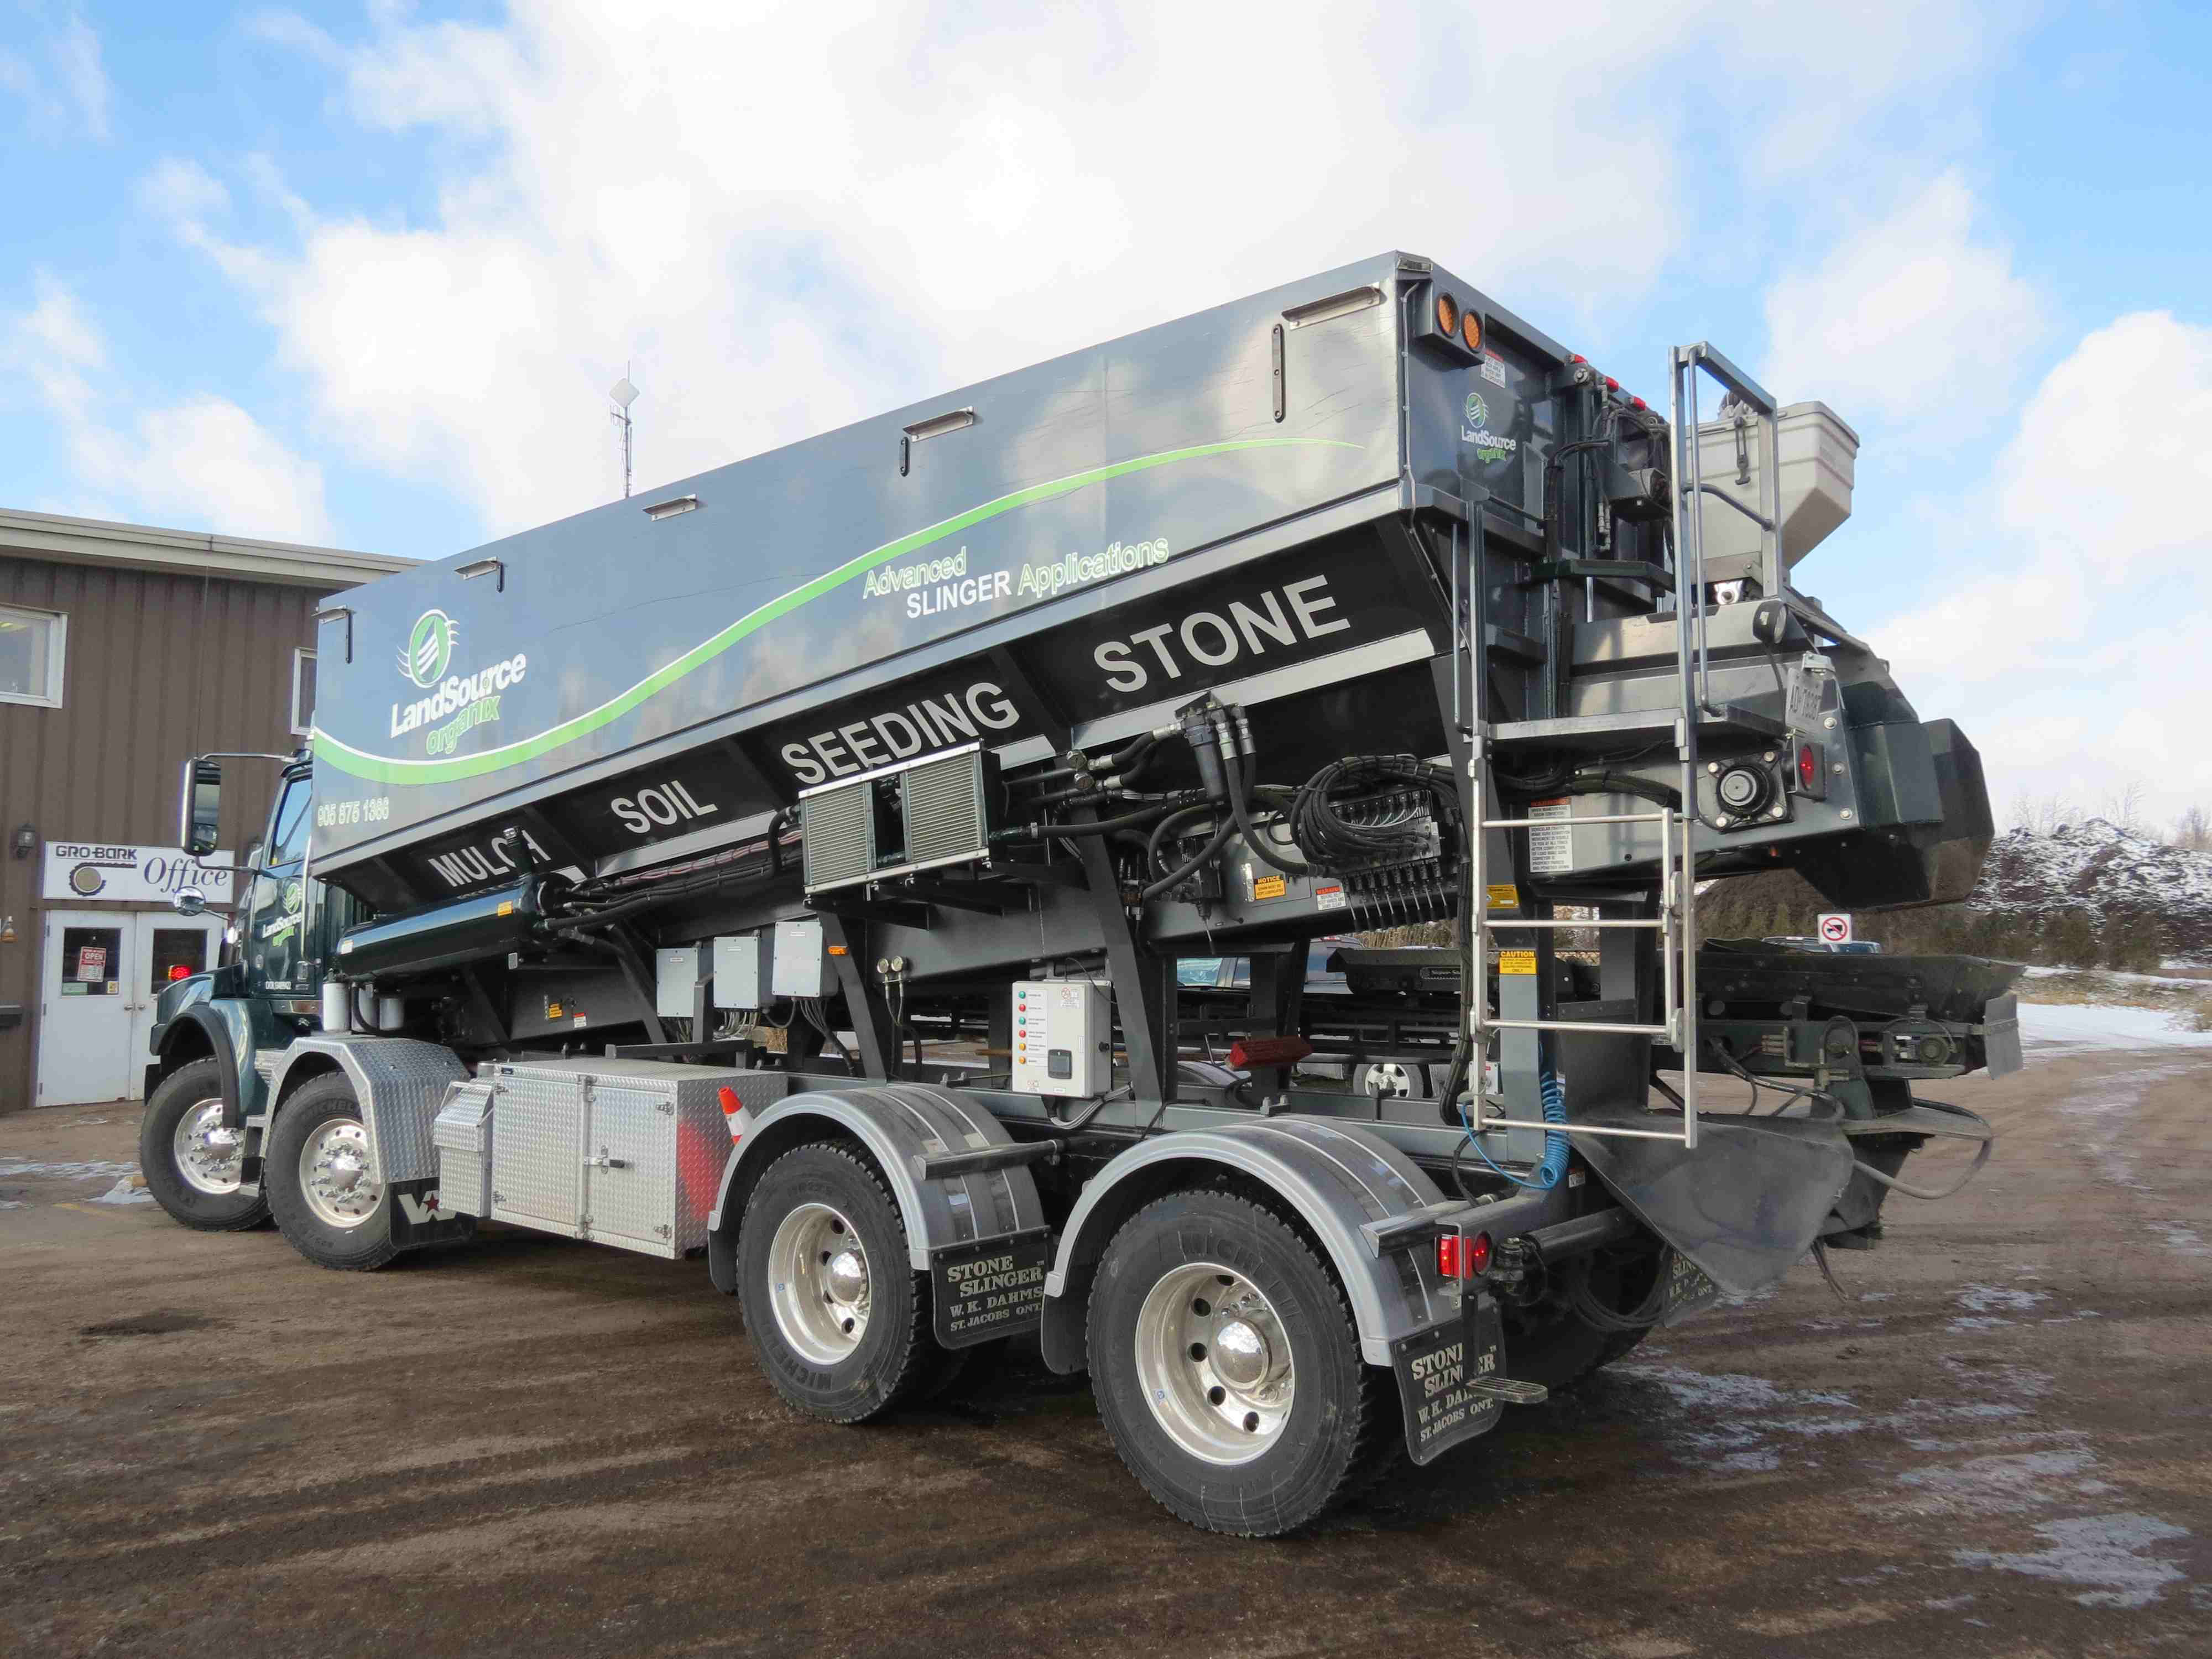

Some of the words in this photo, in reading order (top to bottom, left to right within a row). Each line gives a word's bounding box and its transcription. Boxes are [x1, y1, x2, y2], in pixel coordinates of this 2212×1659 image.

[1461, 425, 1516, 451] LandSource
[863, 546, 967, 599] Advanced
[906, 570, 1012, 618] SLINGER
[1017, 538, 1170, 598] Applications
[1094, 575, 1350, 692] STONE
[390, 653, 526, 738] LandSource
[426, 696, 501, 755] organix
[781, 682, 1020, 784] SEEDING
[611, 780, 718, 833] SOIL
[56, 845, 137, 860] GRO-BARK
[143, 857, 227, 894] Office
[947, 1255, 1014, 1283] STONE
[959, 1266, 1044, 1297] SLINGER
[950, 1304, 964, 1317] W.
[967, 1300, 982, 1313] K.
[987, 1286, 1044, 1309] DAHMS
[967, 1309, 1010, 1327] JACOBS
[1418, 1406, 1431, 1425] W.
[1432, 1408, 1465, 1434] JACOBS
